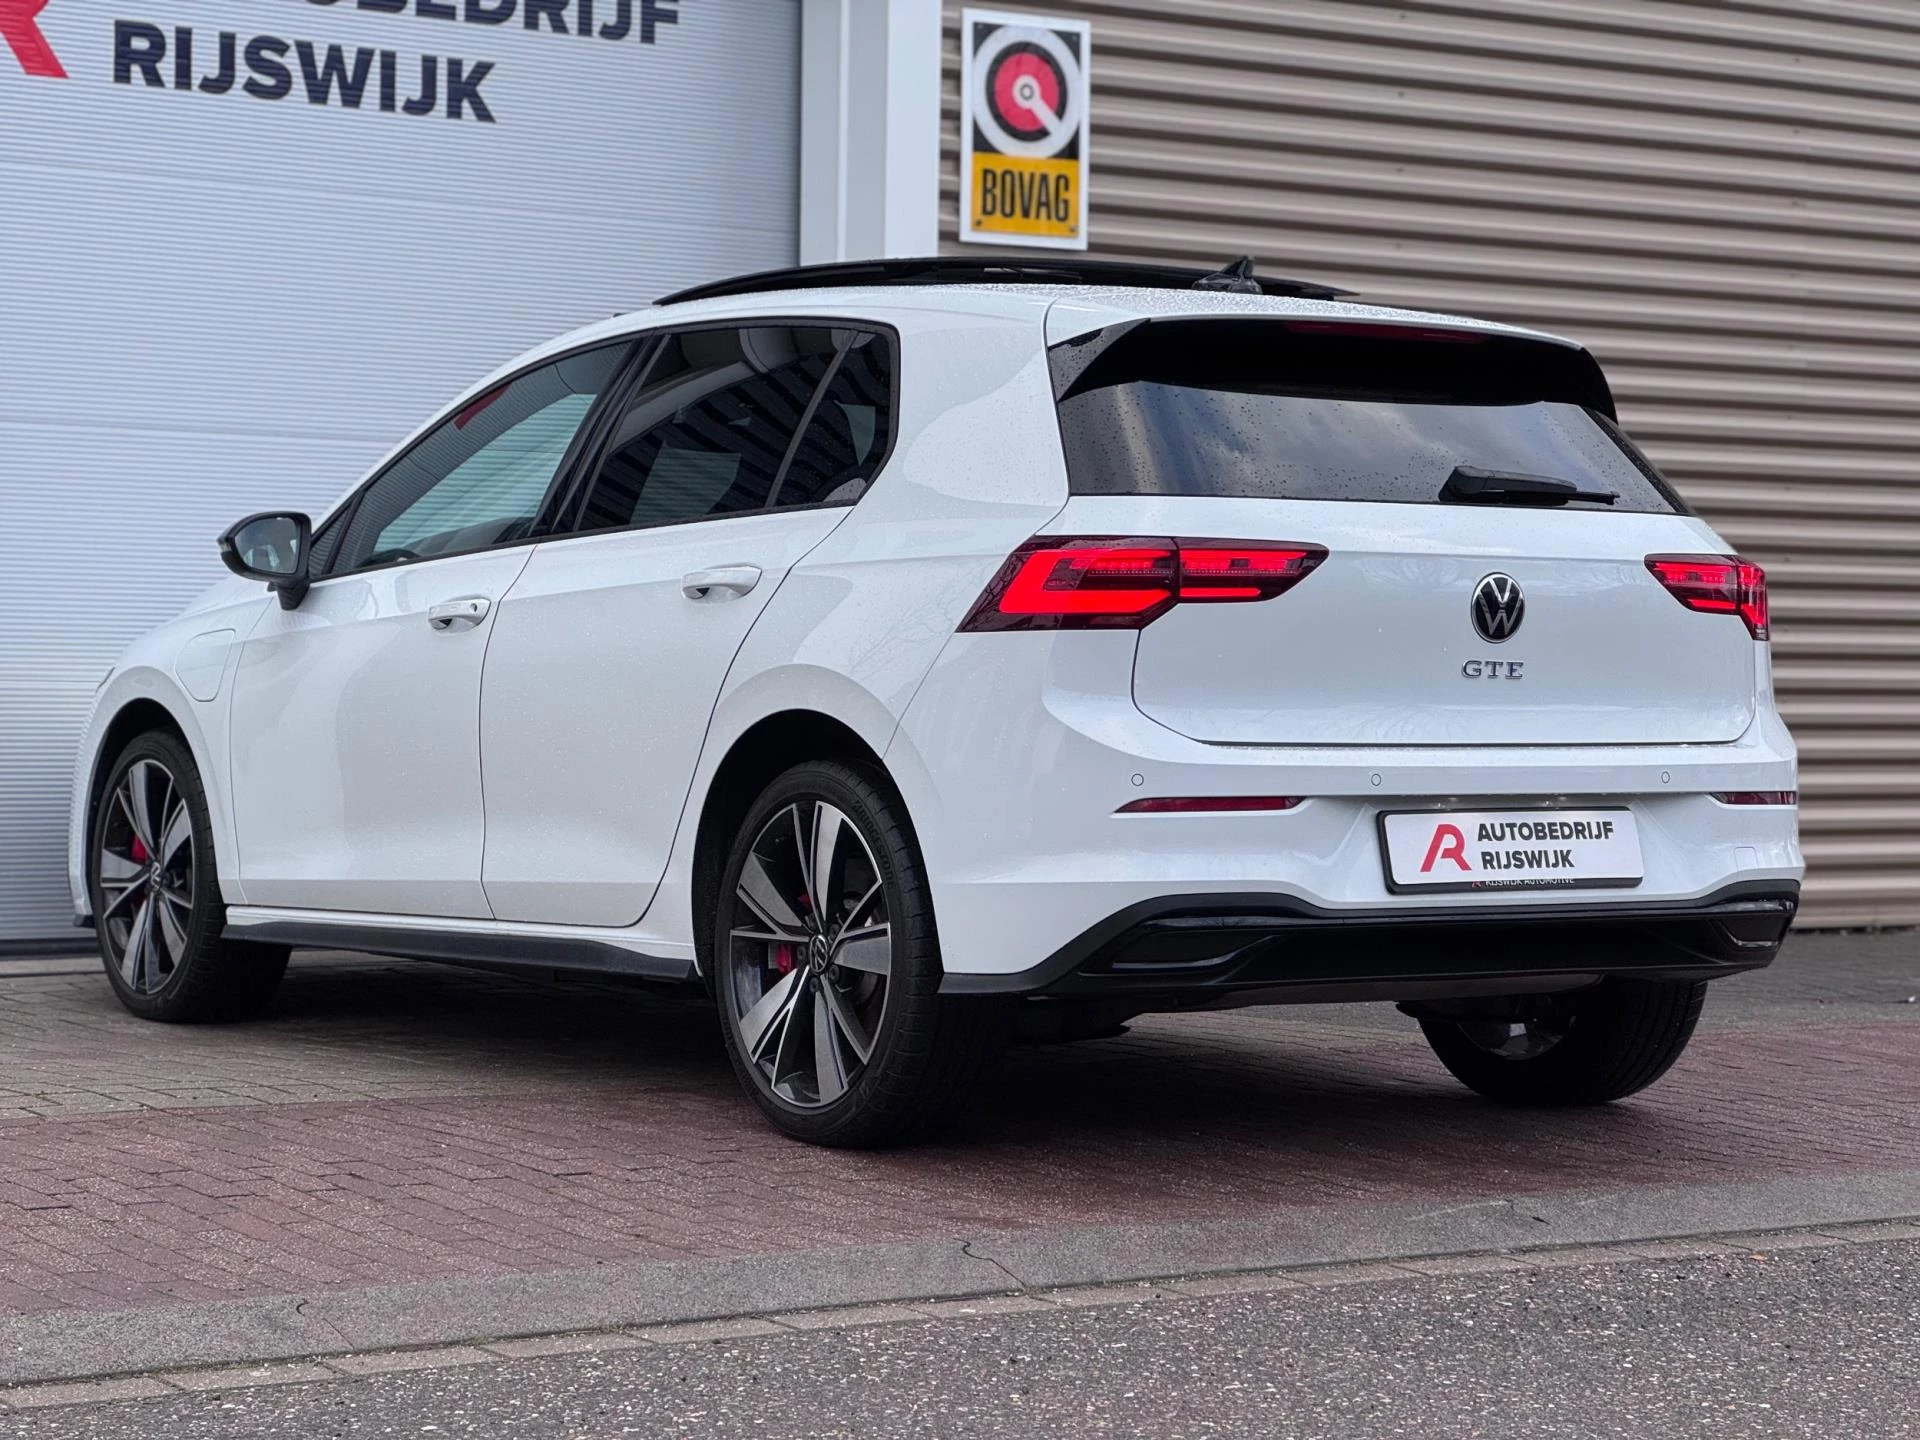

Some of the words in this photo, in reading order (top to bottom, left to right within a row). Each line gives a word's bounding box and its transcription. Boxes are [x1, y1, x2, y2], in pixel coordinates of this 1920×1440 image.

[113, 19, 496, 124] RIJSWIJK
[981, 168, 1070, 222] BOVAG
[1462, 660, 1524, 680] GTE
[1477, 821, 1614, 841] AUTOBEDRIJF
[1481, 849, 1575, 870] RIJSWIJK
